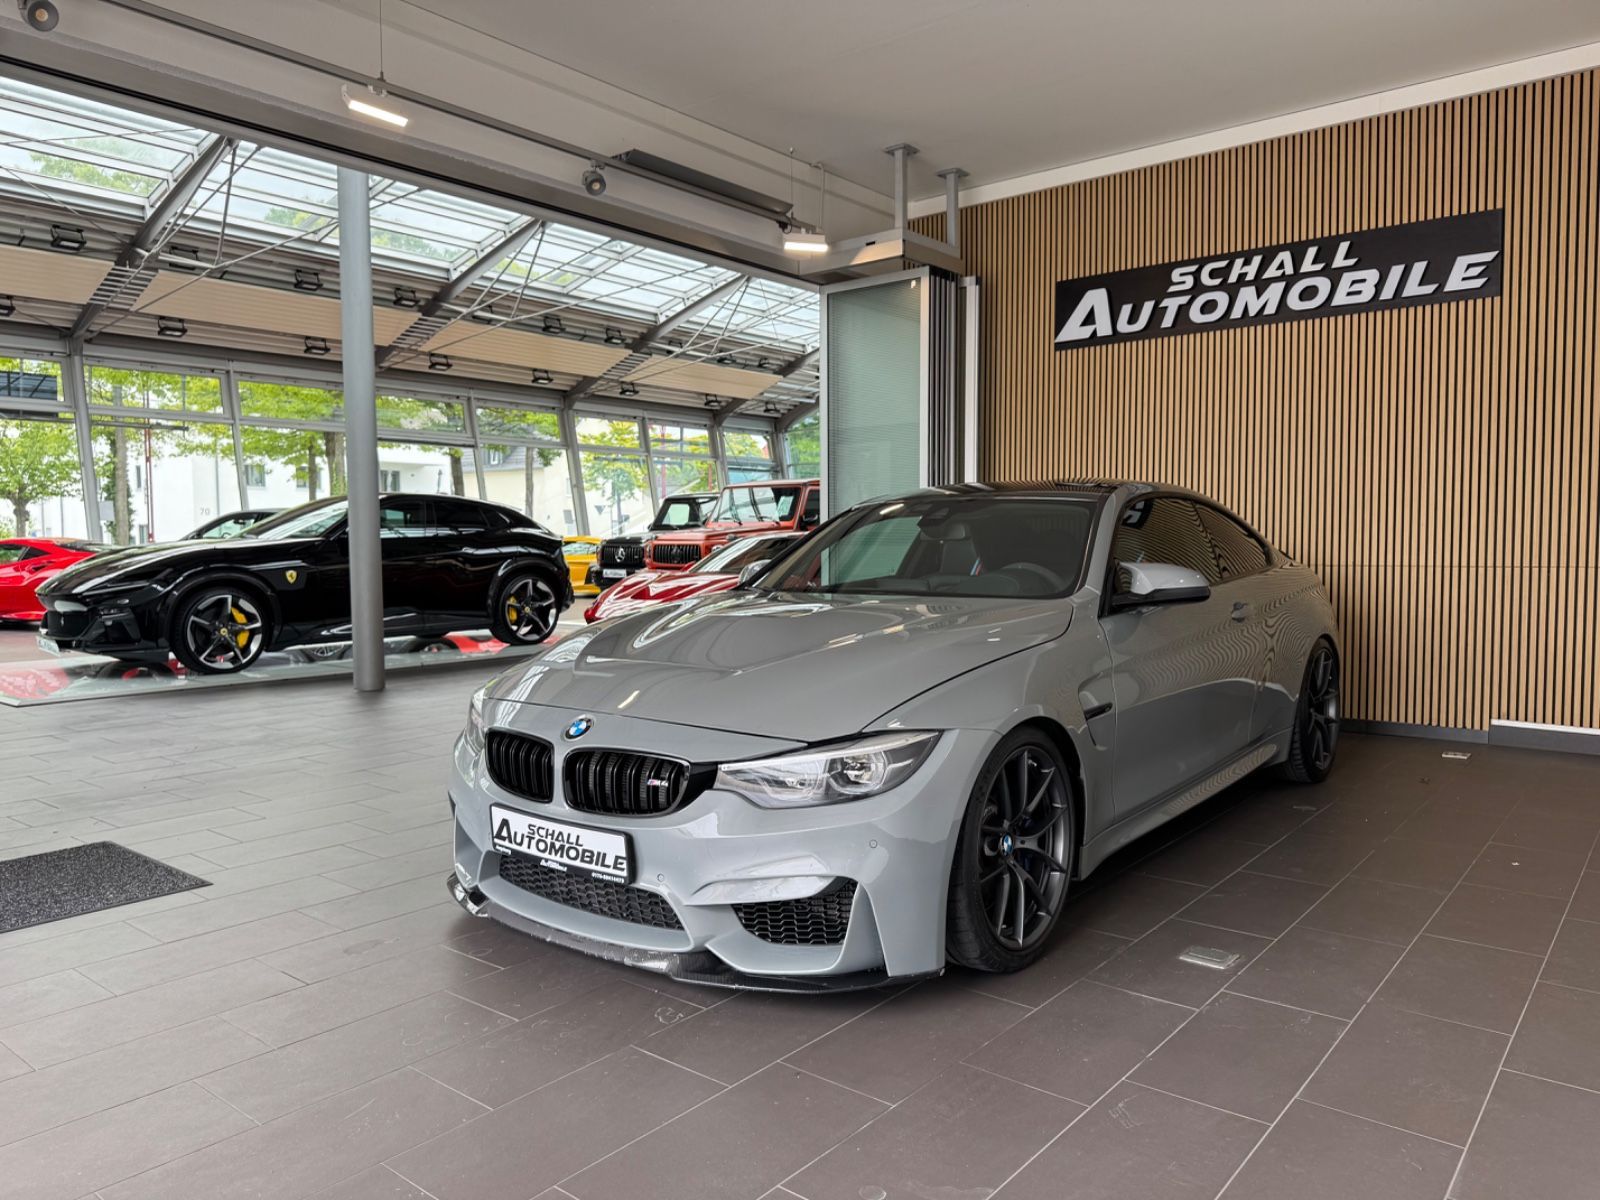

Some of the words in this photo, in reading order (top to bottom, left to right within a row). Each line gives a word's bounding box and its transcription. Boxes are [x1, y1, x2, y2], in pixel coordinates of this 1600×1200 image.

[1166, 241, 1359, 293] SCHALL
[1054, 250, 1500, 343] AUTOMOBILE
[493, 817, 627, 872] AUTOMOBILE
[527, 823, 584, 848] SCHALL
